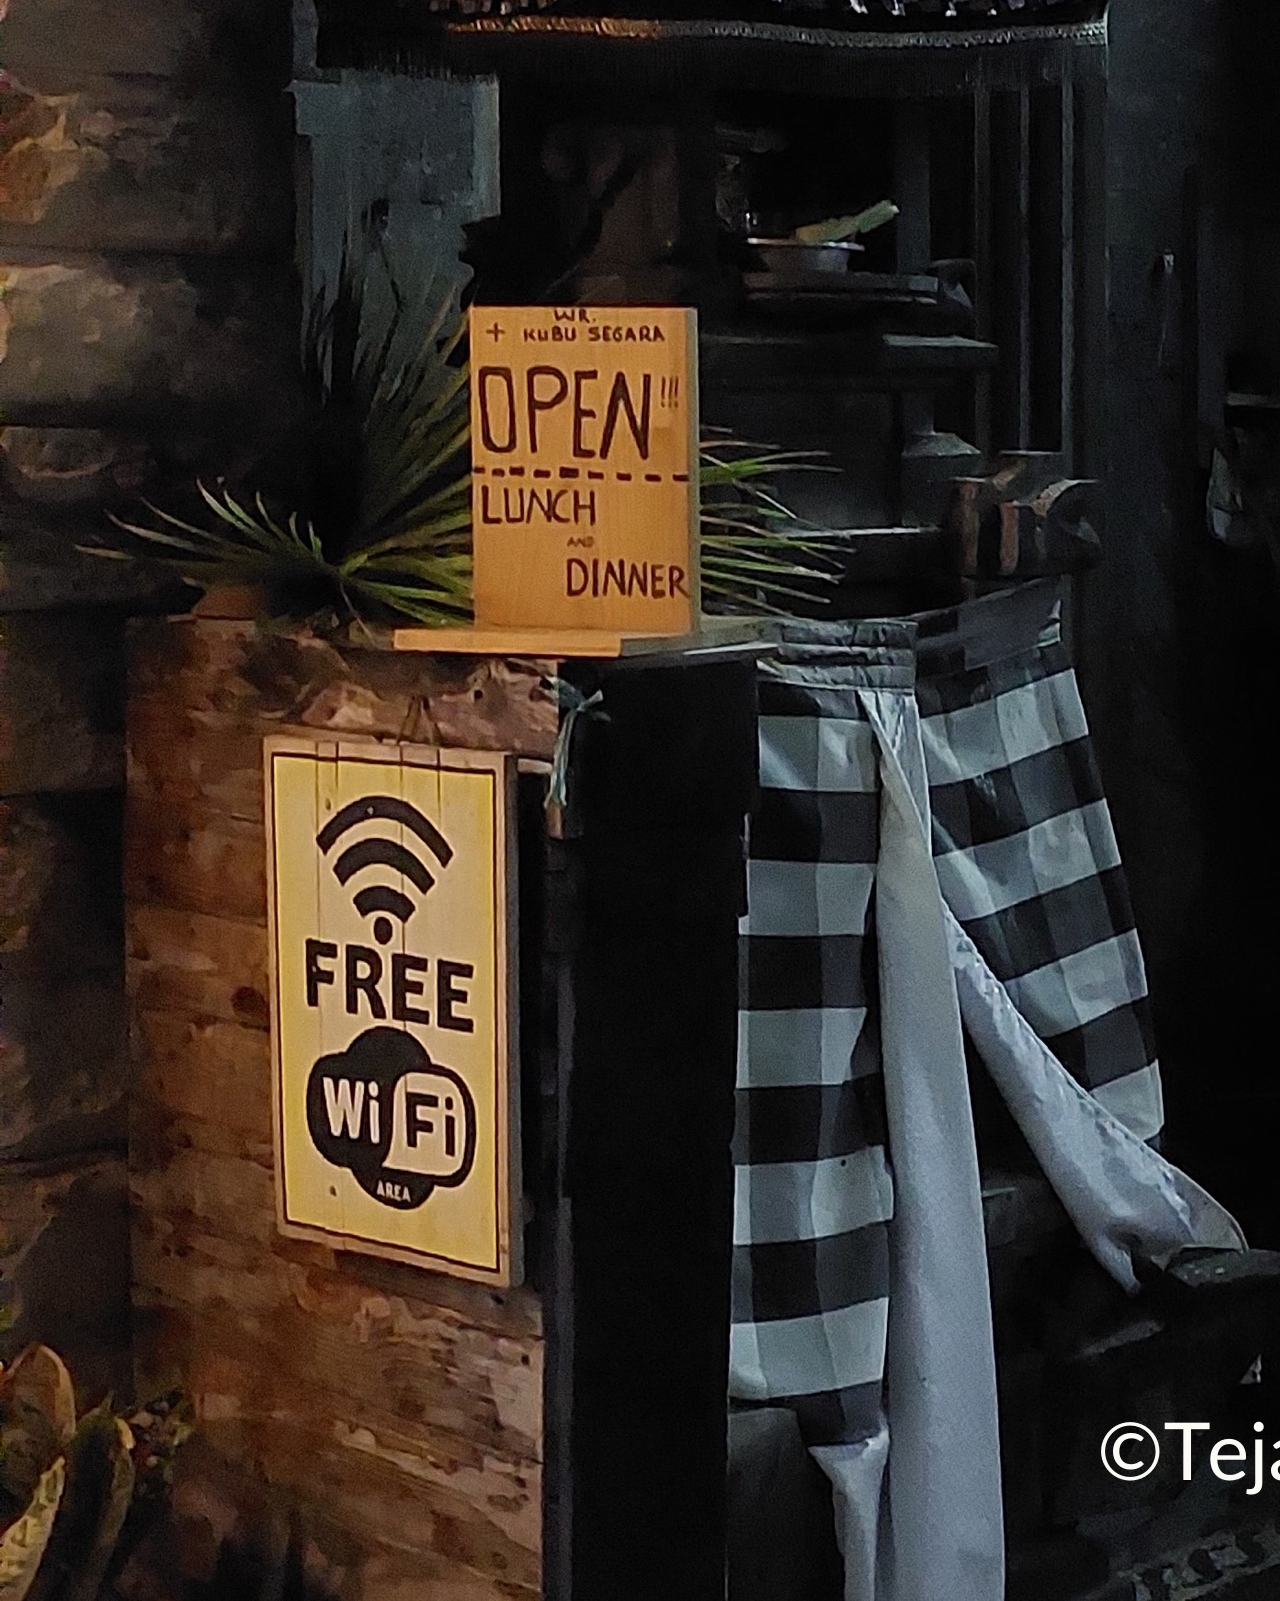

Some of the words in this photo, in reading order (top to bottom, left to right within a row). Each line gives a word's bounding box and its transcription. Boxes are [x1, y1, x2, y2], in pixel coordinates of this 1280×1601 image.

[554, 309, 597, 322] WR.
[588, 325, 666, 343] SEGARA
[481, 484, 596, 526] LUNCH
[566, 536, 595, 548] AND
[566, 558, 689, 600] DINNER
[305, 937, 475, 1034] FREE
[376, 1180, 412, 1203] AREA
